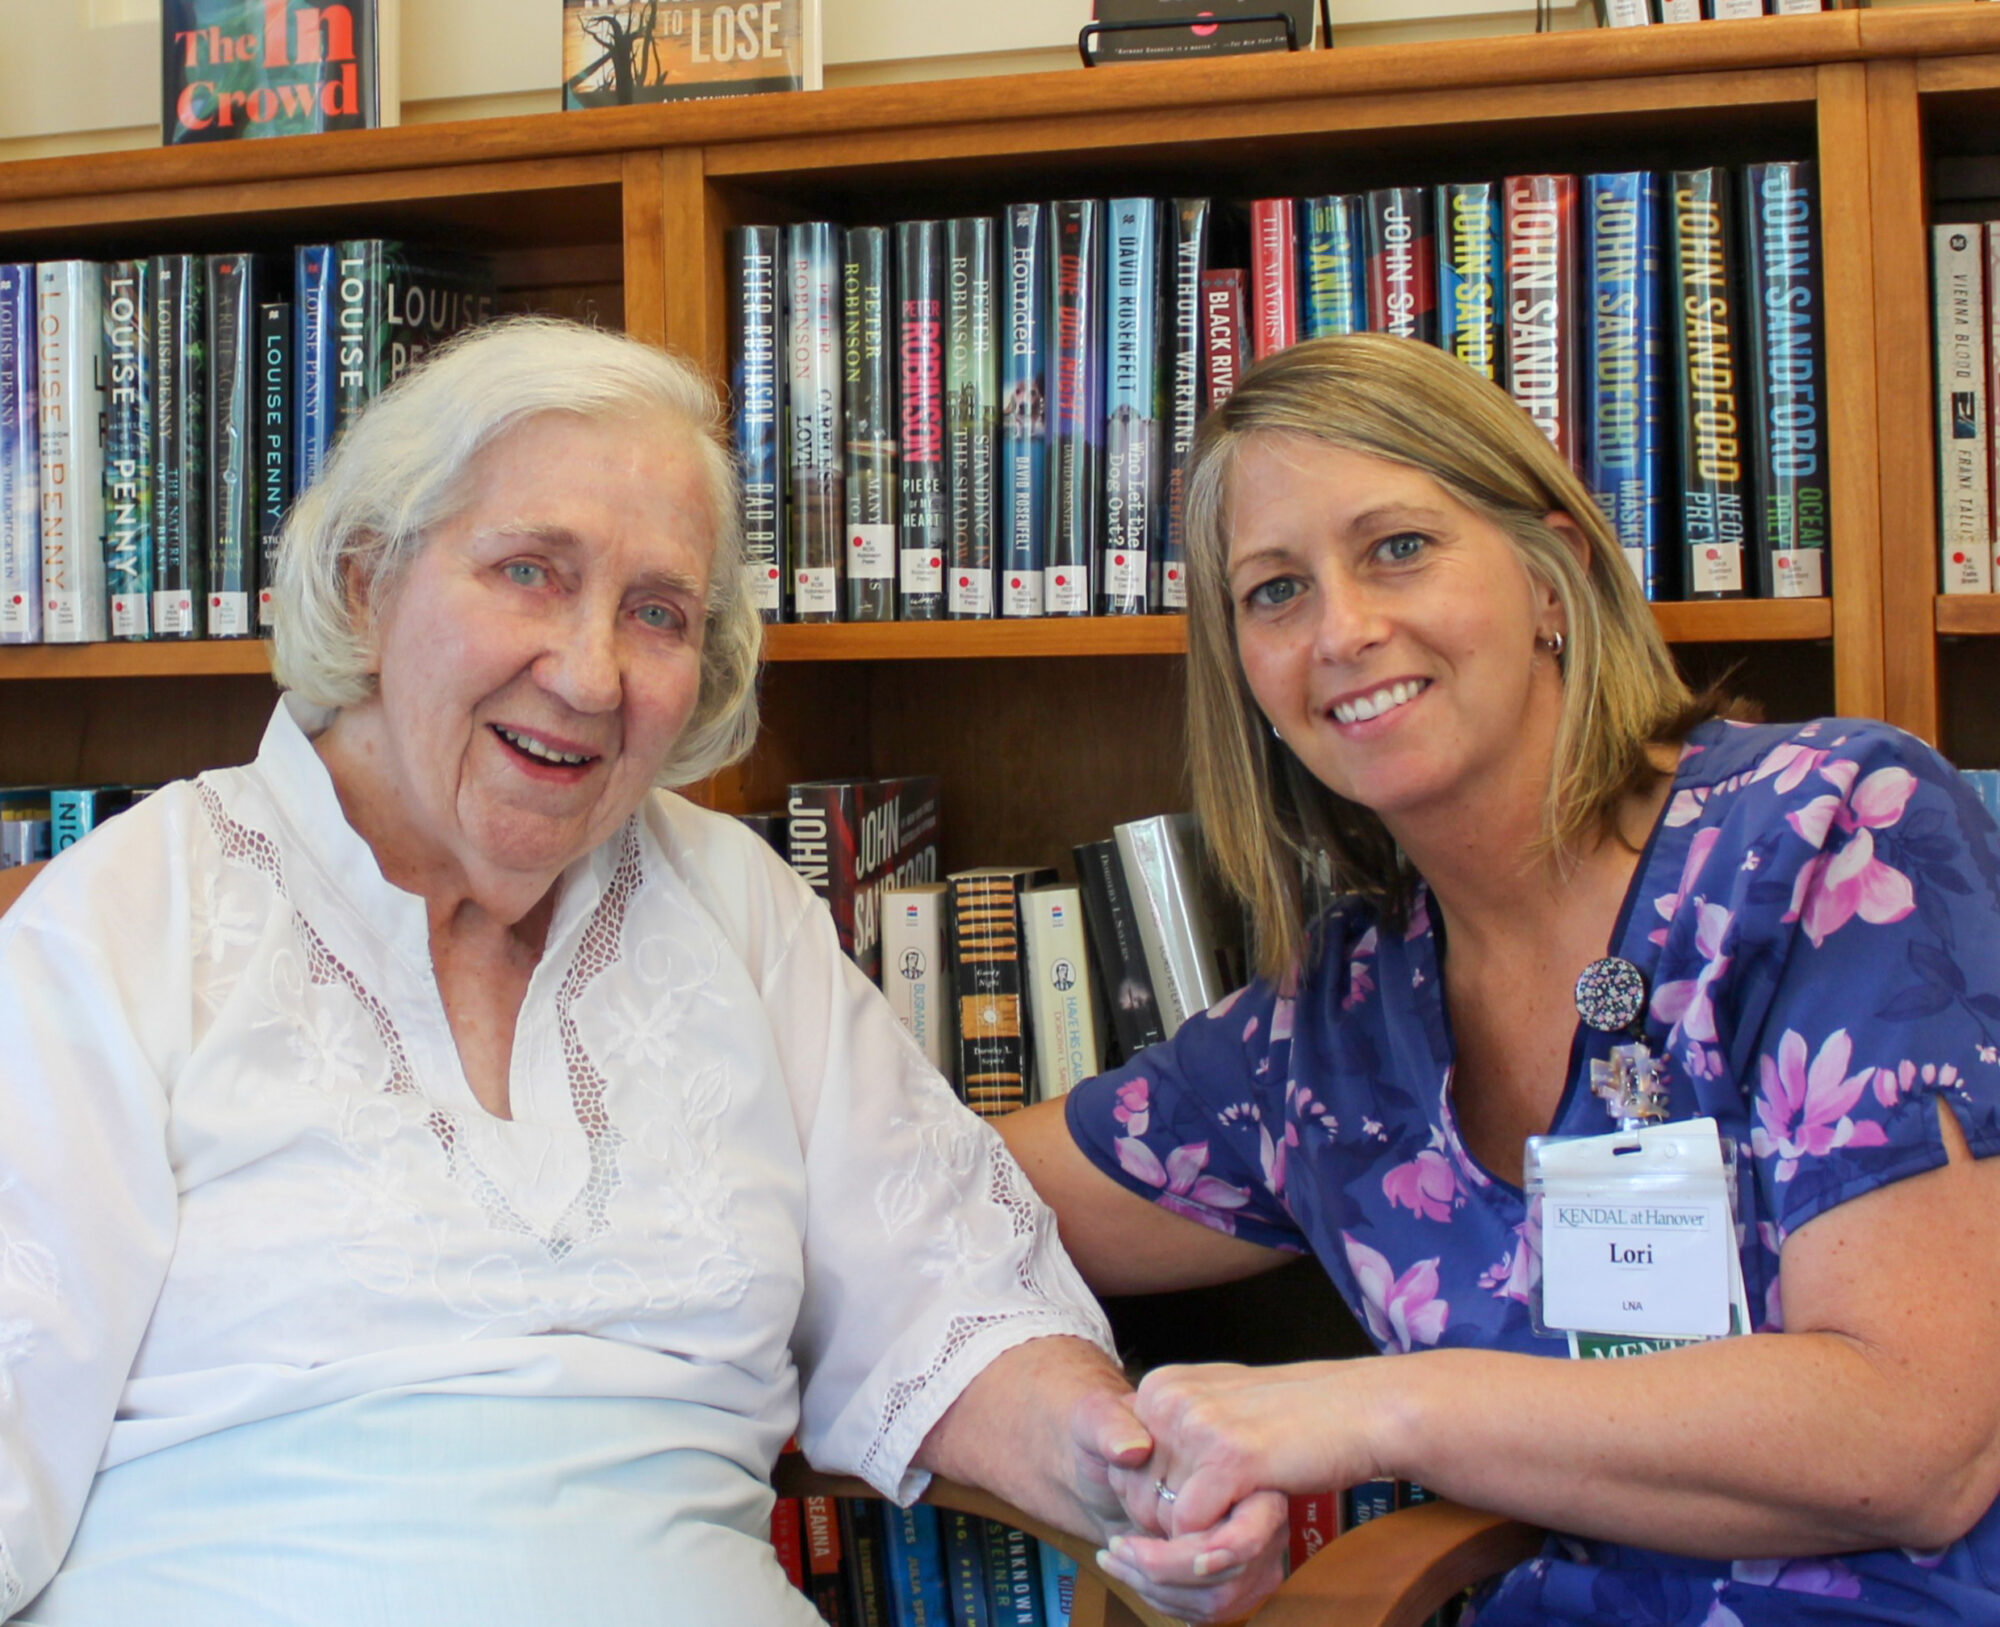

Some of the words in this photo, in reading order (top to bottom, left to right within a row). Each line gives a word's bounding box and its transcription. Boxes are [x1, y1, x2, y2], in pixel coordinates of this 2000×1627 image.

[175, 26, 258, 67] The
[262, 0, 356, 68] In
[662, 9, 683, 37] TO
[691, 1, 783, 63] LOSE
[176, 63, 360, 130] Crowd
[1262, 215, 1279, 249] THE
[1384, 206, 1413, 282] JOHN
[1453, 193, 1492, 275] JOHN
[1510, 189, 1557, 290] JOHN
[1595, 190, 1638, 283] JOHN
[1674, 189, 1725, 287] JOHN
[1761, 172, 1808, 278] JOHN
[743, 255, 773, 315] PETER
[1058, 254, 1082, 298] ONE
[1117, 236, 1136, 287] DAVID
[1176, 240, 1197, 339] WITHOUT
[1310, 237, 1353, 338] SANDFO
[1, 299, 13, 364] LOUISE
[304, 287, 320, 352] LOUISE
[340, 258, 364, 388] LOUISE
[388, 283, 492, 332] LOUISE
[794, 260, 811, 381] ROBINSON
[816, 282, 831, 355] PETER
[845, 262, 861, 383] ROBINSON
[864, 284, 881, 360] PETER
[902, 300, 940, 317] PETER
[952, 257, 968, 381] ROBINSON
[973, 279, 989, 354] PETER
[1012, 246, 1036, 356] Hounded
[1059, 306, 1084, 349] DOG
[1208, 291, 1231, 351] BLACK
[1263, 262, 1281, 339] MAYORS
[1455, 282, 1494, 380] SANDF
[1953, 273, 1969, 326] VIENNA
[40, 291, 61, 423] LOUISE
[110, 278, 135, 405] LOUISE
[157, 298, 172, 372] LOUISE
[1117, 296, 1136, 393] ROSENFELT
[1955, 333, 1970, 380] BLOOD
[1, 370, 14, 427] PENNY
[266, 335, 282, 425] LOUISE
[304, 360, 320, 420] PENNY
[744, 324, 774, 424] ROBINSON
[901, 321, 943, 462] ROBINSON
[1059, 356, 1085, 422] NIGHT
[1174, 349, 1197, 454] WARNING
[1511, 299, 1560, 444] SANDFO
[1597, 291, 1641, 470] SANDFORD
[1683, 294, 1741, 483] SANDFORD
[1766, 286, 1817, 477] SANDFORD
[158, 375, 172, 441] PENNY
[156, 462, 166, 482] OF
[796, 414, 813, 471] LOVE
[816, 388, 833, 495] CARELESS
[953, 426, 969, 470] THE
[1014, 456, 1030, 489] DAVID
[1062, 443, 1074, 478] DAVID
[1107, 453, 1124, 492] Dog
[1128, 441, 1145, 475] Who
[1958, 449, 1972, 489] FRANK
[156, 486, 166, 518] THE
[168, 468, 179, 498] THE
[266, 434, 282, 519] PENNY
[745, 483, 775, 521] BAD
[849, 493, 861, 518] TO
[867, 477, 881, 523] MANY
[902, 478, 939, 493] PIECE
[920, 497, 933, 508] MY
[974, 434, 990, 538] STANDING
[1128, 480, 1145, 512] Let
[1168, 467, 1184, 546] ROSENFELT
[43, 462, 65, 590] PENNY
[112, 459, 138, 578] PENNY
[168, 501, 179, 566] NATURE
[902, 513, 940, 527] HEART
[953, 475, 969, 568] SHADOW
[1014, 492, 1031, 552] ROSENFELT
[1062, 480, 1074, 539] ROSENFELT
[1109, 496, 1124, 546] Out?
[1128, 515, 1145, 549] the
[1619, 480, 1645, 549] MASKE
[1685, 490, 1713, 545] PREY
[1766, 494, 1793, 545] PREY
[1797, 487, 1825, 553] OCEAN
[156, 524, 166, 573] BEAST
[745, 531, 774, 566] BOY
[976, 545, 990, 568] IN
[59, 802, 76, 850] NIC
[788, 797, 829, 887] JOHN
[855, 795, 900, 880] JOHN
[1100, 854, 1118, 903] DOROTHY
[912, 983, 928, 1049] BUSMAN'
[1065, 996, 1079, 1028] HAVE
[1163, 975, 1179, 1006] PETER
[1068, 1030, 1081, 1049] HIS
[1070, 1051, 1085, 1081] CAR
[1558, 1208, 1628, 1228] KENDAL
[1630, 1212, 1643, 1225] at
[1645, 1209, 1705, 1227] Hanover
[1609, 1242, 1653, 1264] Lori
[1622, 1300, 1643, 1311] LNA
[1592, 1338, 1692, 1361] MENT
[808, 1495, 830, 1558] SEANNA
[906, 1556, 923, 1595] JULIA
[961, 1558, 977, 1627] PRESUM
[989, 1523, 1011, 1607] STEINER
[1007, 1529, 1034, 1625] UNKNOWN
[912, 1598, 927, 1627] SPE
